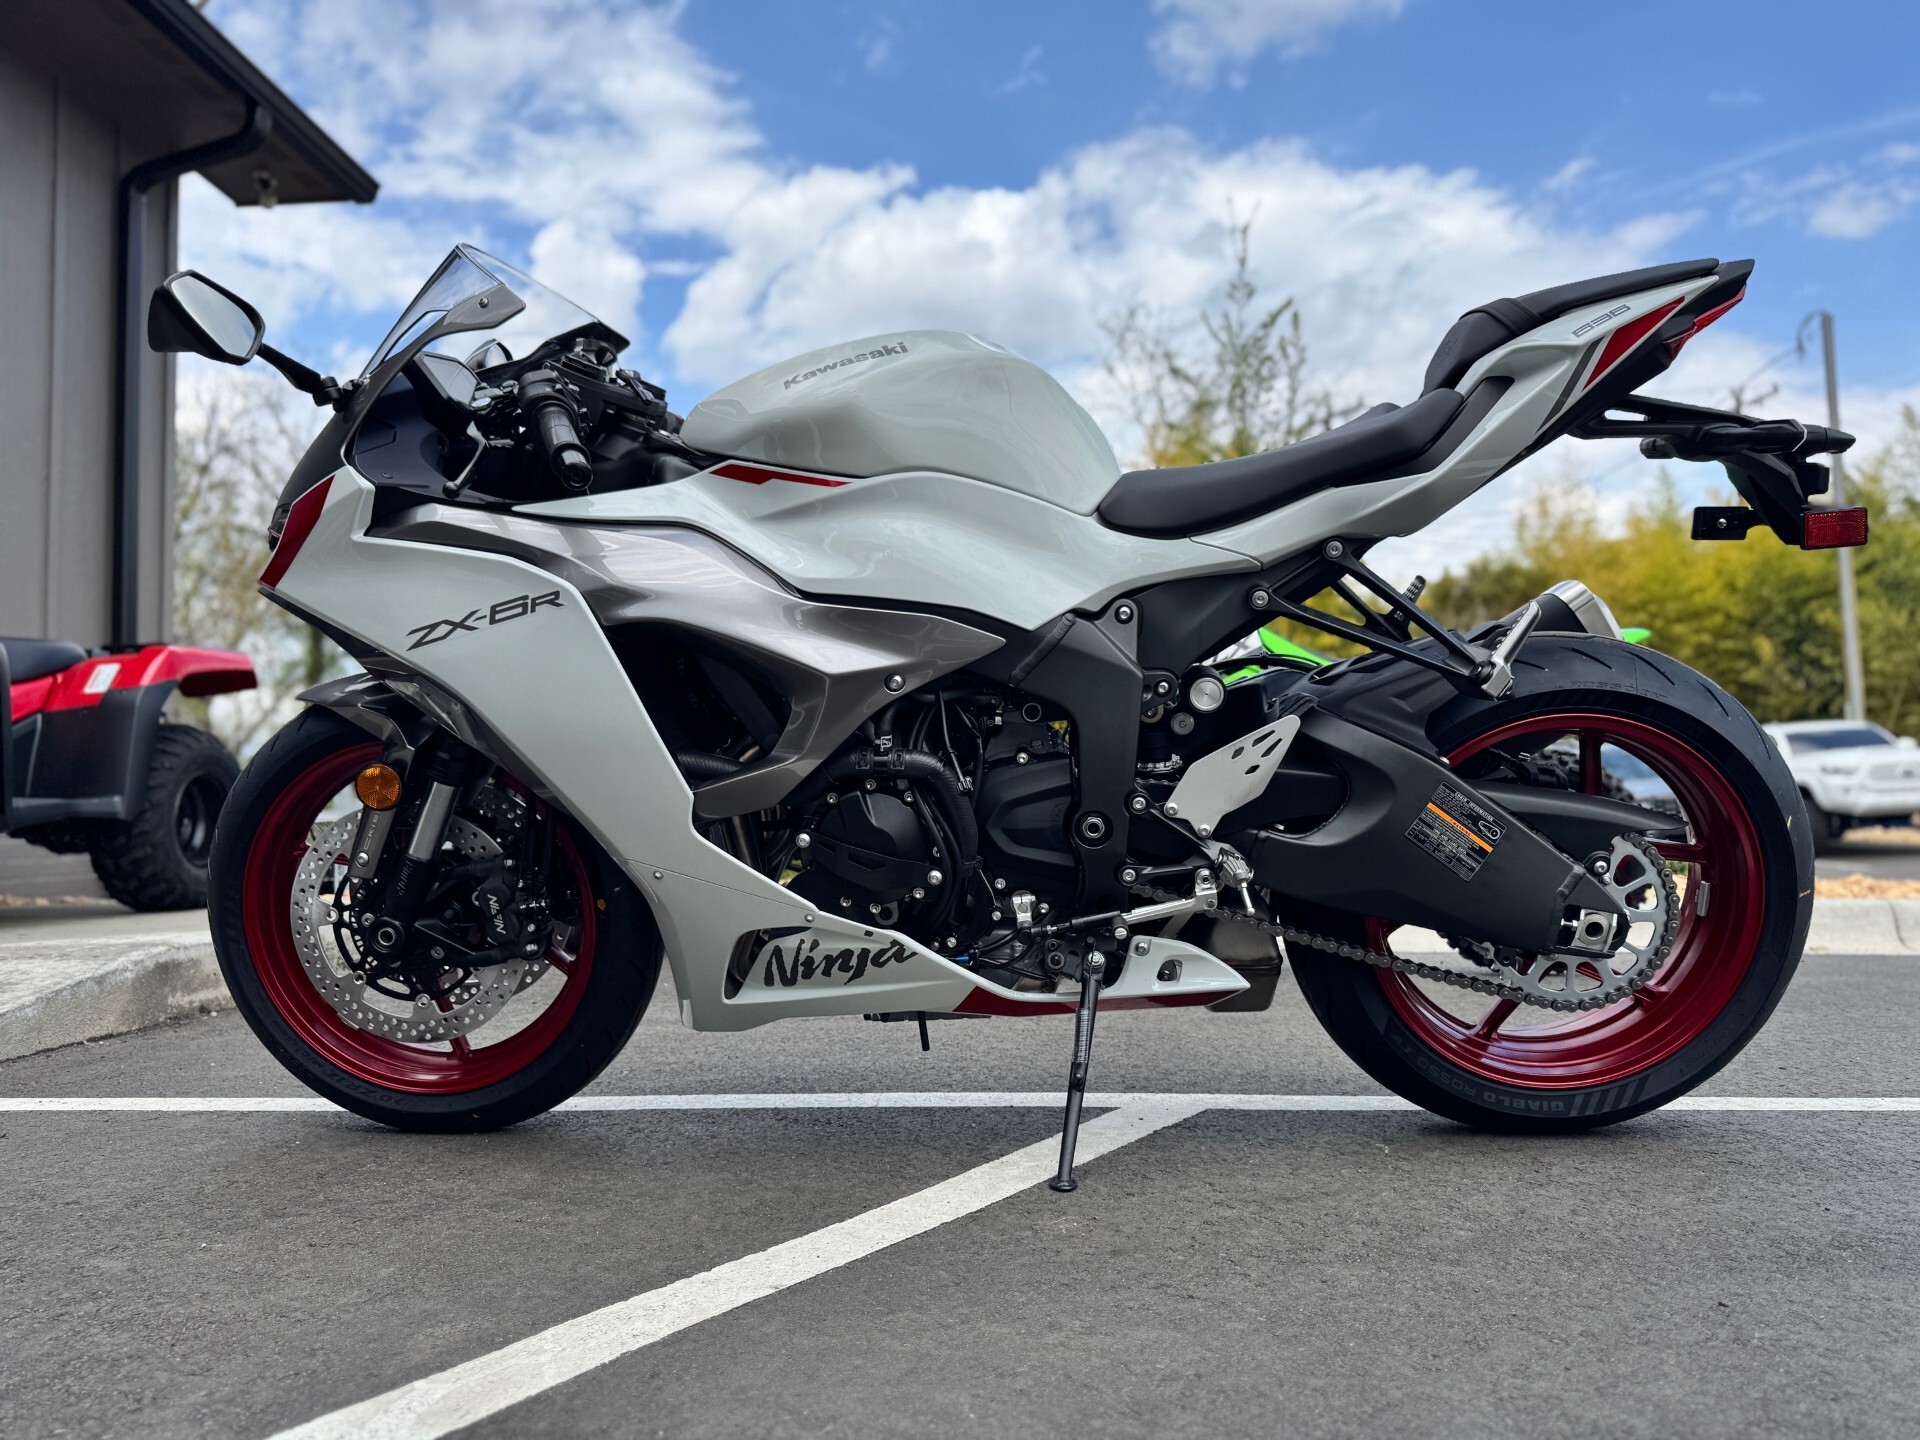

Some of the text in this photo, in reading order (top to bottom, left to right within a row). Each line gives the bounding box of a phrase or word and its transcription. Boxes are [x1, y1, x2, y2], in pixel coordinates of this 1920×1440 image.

[1572, 304, 1632, 338] 636
[783, 341, 909, 390] Kawasaki
[405, 590, 565, 652] ZX-6R
[764, 938, 919, 987] Ninja
[1416, 1056, 1476, 1096] ROSSO
[1483, 1091, 1566, 1114] DIABLO
